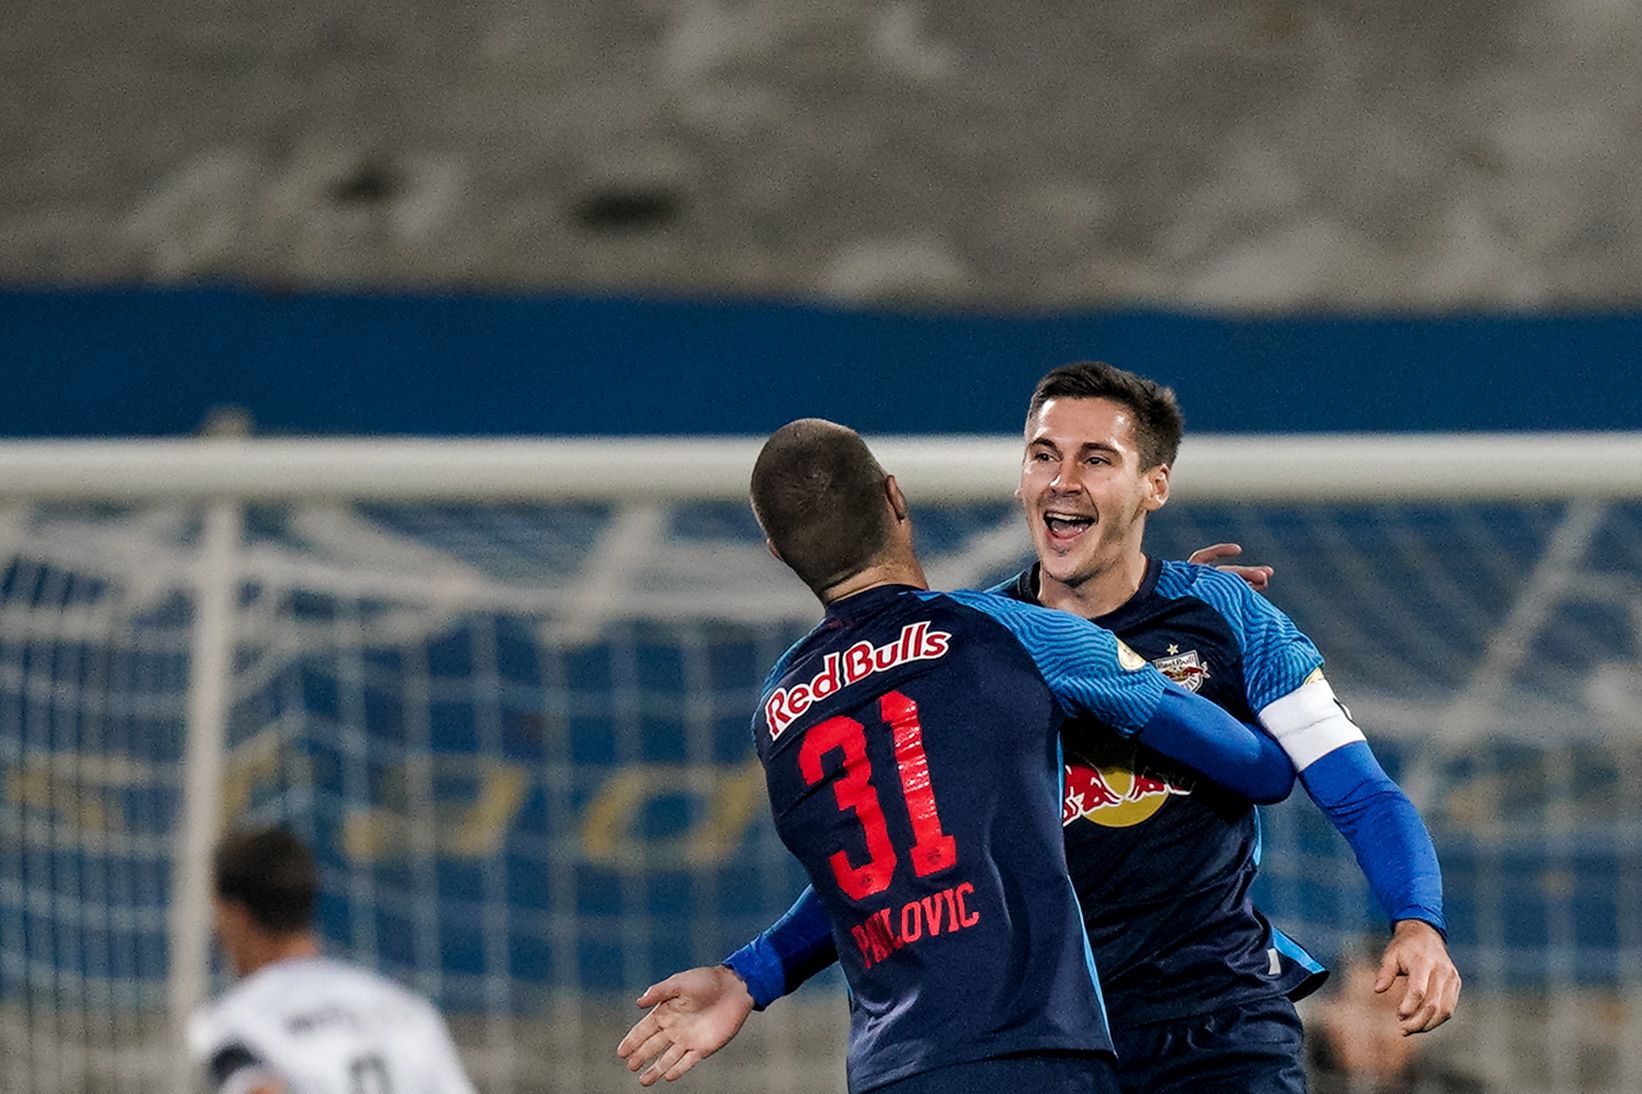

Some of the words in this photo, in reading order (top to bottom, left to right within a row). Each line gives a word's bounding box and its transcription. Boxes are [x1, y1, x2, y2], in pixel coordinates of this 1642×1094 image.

[765, 651, 841, 741] Red
[842, 620, 952, 687] Bulls
[798, 691, 957, 900] 31
